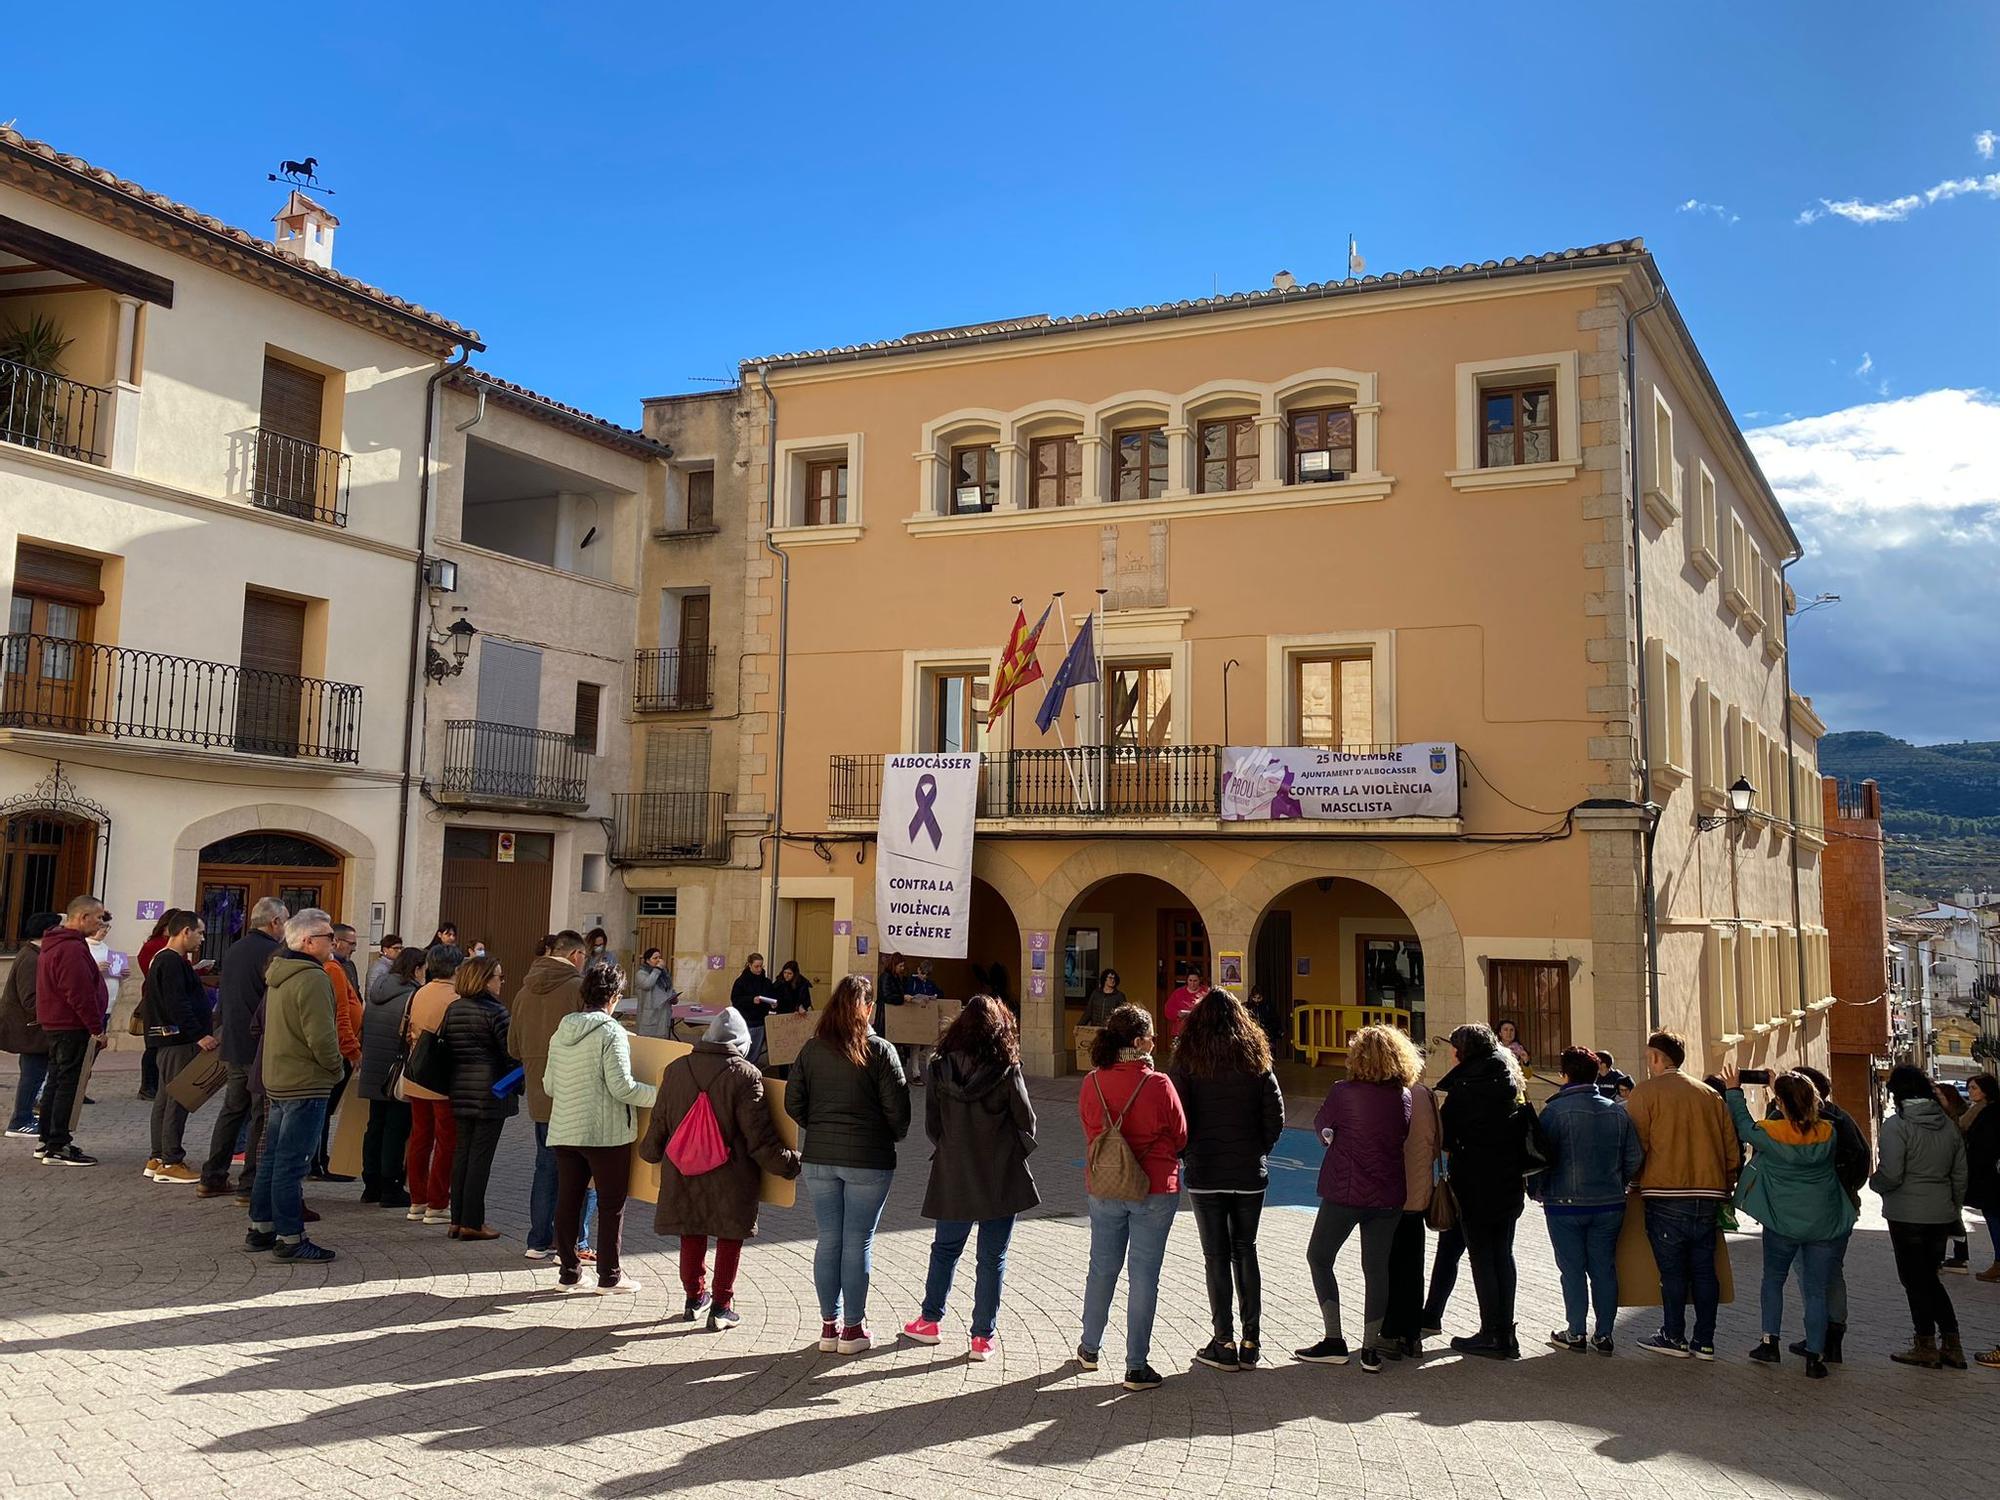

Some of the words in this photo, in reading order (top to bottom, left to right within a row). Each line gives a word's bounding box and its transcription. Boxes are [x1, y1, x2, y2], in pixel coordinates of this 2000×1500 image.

[891, 754, 971, 770] ALBOCÀSSER
[1316, 754, 1329, 764] 25
[1301, 770, 1353, 779] AJUNTAMENT
[1356, 766, 1417, 776] D'ALBOCÀSSER
[1289, 785, 1340, 796] CONTRA
[1343, 785, 1358, 796] LA
[1362, 781, 1432, 795] VIOLÈNCIA
[1321, 802, 1392, 813] MASCLISTA
[889, 878, 936, 891] CONTRA
[938, 880, 954, 892] LA
[890, 899, 951, 916] VIOLÈNCIA
[888, 925, 902, 937] DE
[905, 922, 952, 939] GÈNERE
